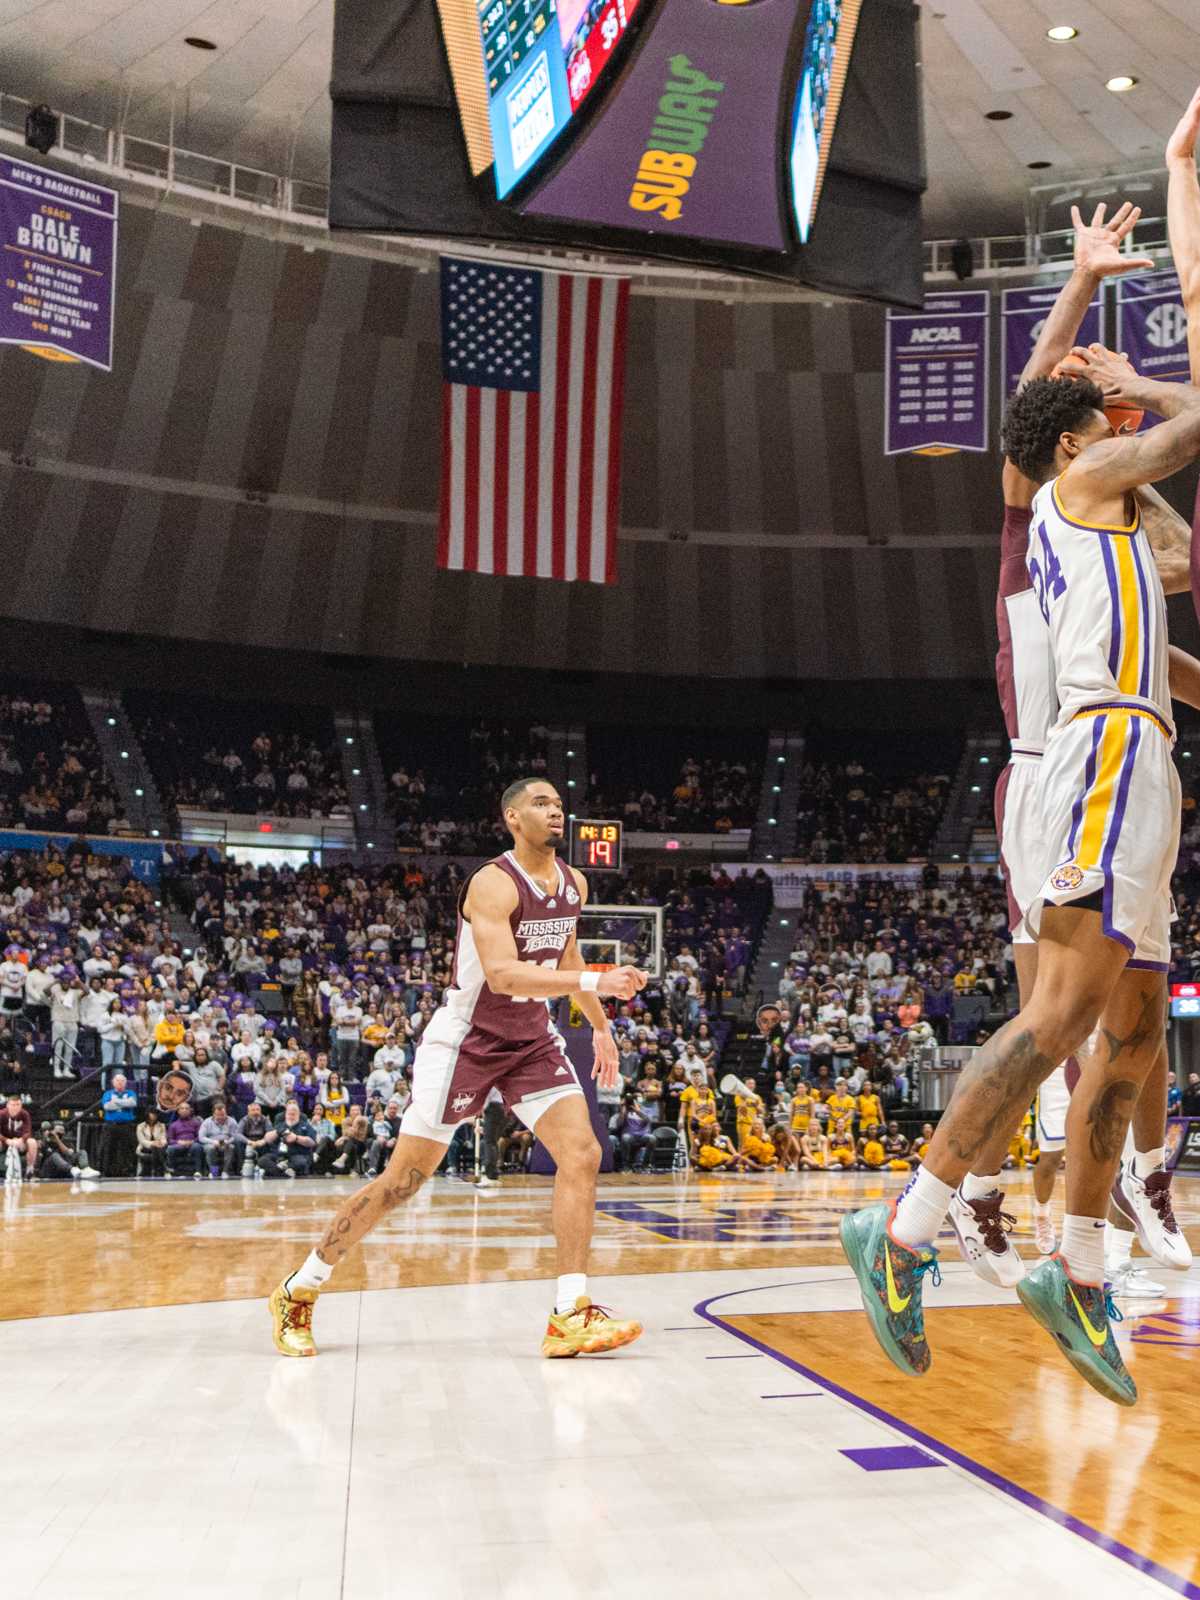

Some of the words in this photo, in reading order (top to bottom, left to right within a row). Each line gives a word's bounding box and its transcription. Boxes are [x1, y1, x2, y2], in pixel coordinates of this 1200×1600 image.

[629, 54, 725, 221] SUBWAY
[11, 167, 43, 186] MEN'S
[44, 178, 103, 205] BASKETBALL
[41, 204, 72, 220] COACH
[31, 213, 81, 243] DALE
[17, 226, 92, 265] BROWN
[32, 262, 56, 275] FINAL
[56, 268, 83, 284] FOURS
[35, 275, 51, 287] SEC
[52, 279, 79, 295] TITLES
[17, 281, 40, 297] NCAA
[41, 288, 99, 312] TOURNAMENTS
[12, 302, 40, 317] COACH
[41, 310, 52, 320] OF
[910, 326, 962, 344] NCAA
[579, 826, 618, 840] 14:13
[589, 841, 611, 865] 19
[528, 935, 563, 951] STATE
